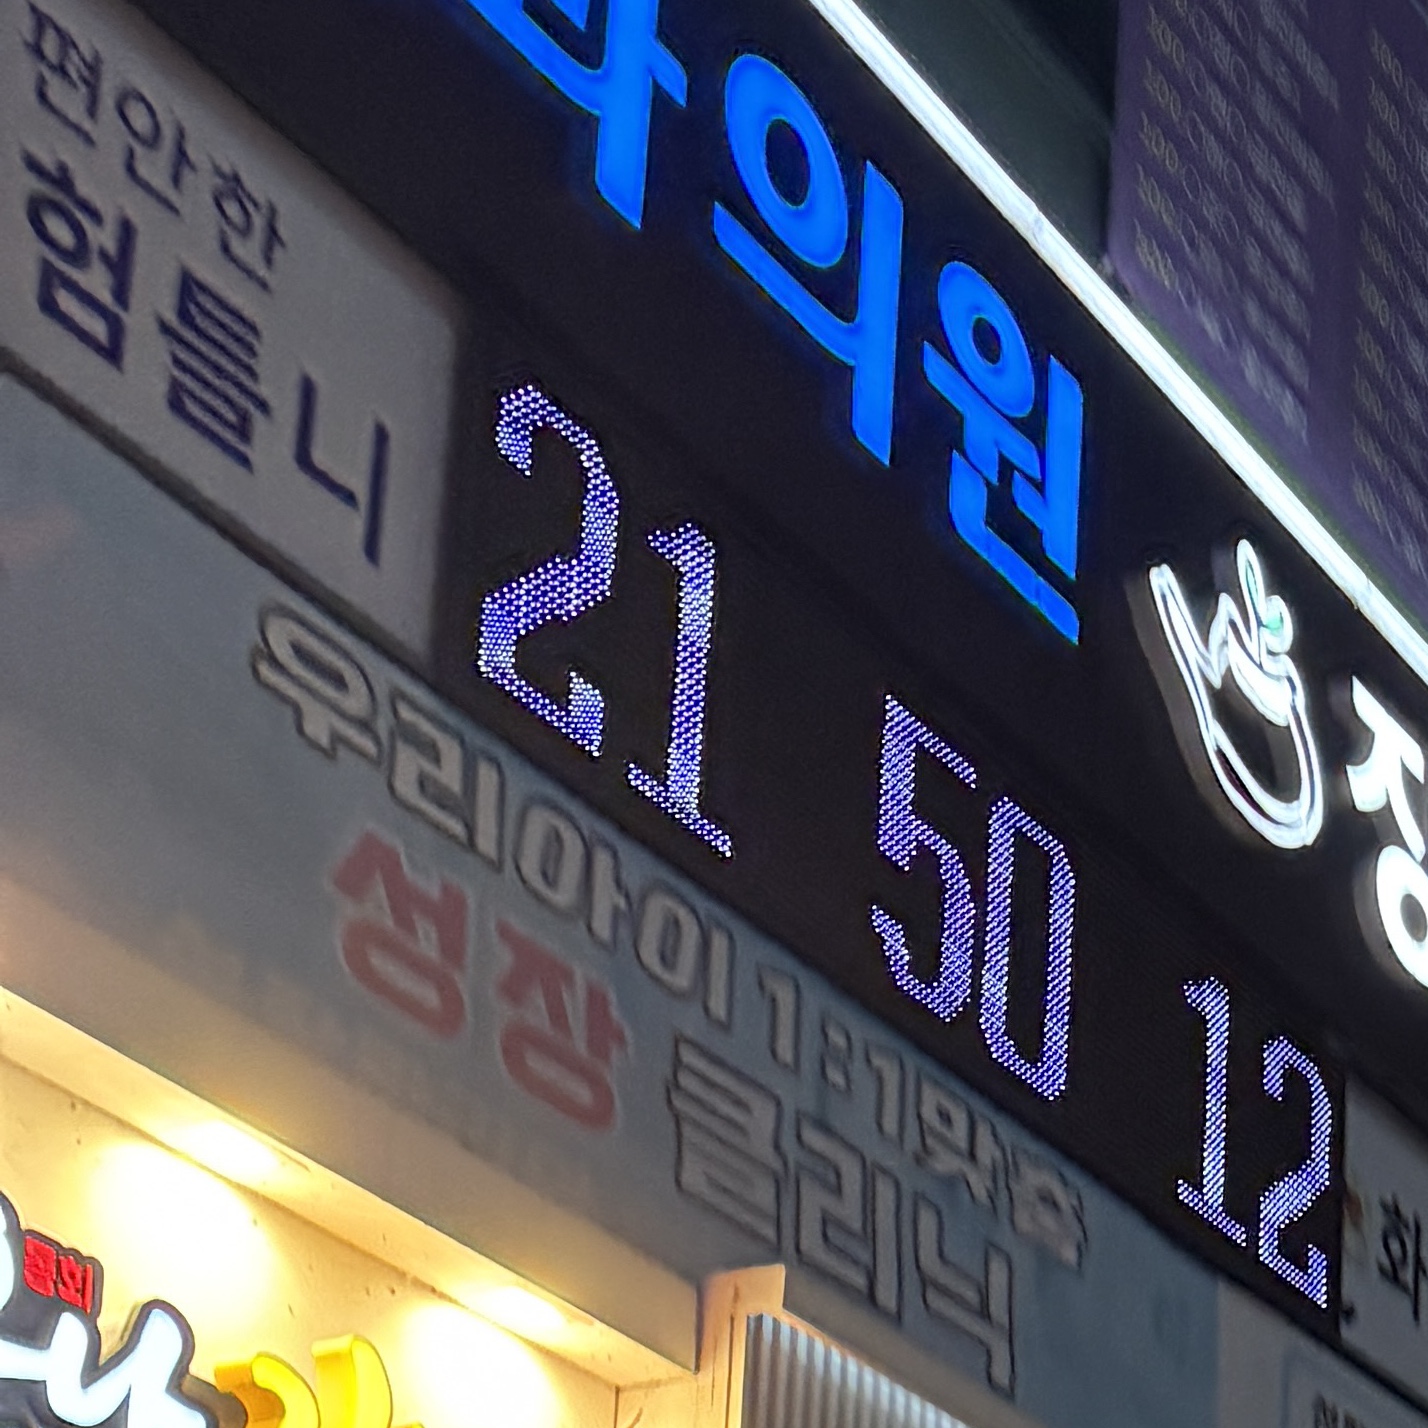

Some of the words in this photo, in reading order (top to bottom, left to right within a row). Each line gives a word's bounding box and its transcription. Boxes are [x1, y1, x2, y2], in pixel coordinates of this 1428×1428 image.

[20, 2, 288, 294] 편안한
[248, 598, 738, 1032] 우리아이
[330, 826, 632, 1132] 성장
[476, 383, 738, 862] 21
[870, 692, 1076, 1102] 50
[1176, 972, 1334, 1310] 12
[665, 1028, 1020, 1398] 클리닉
